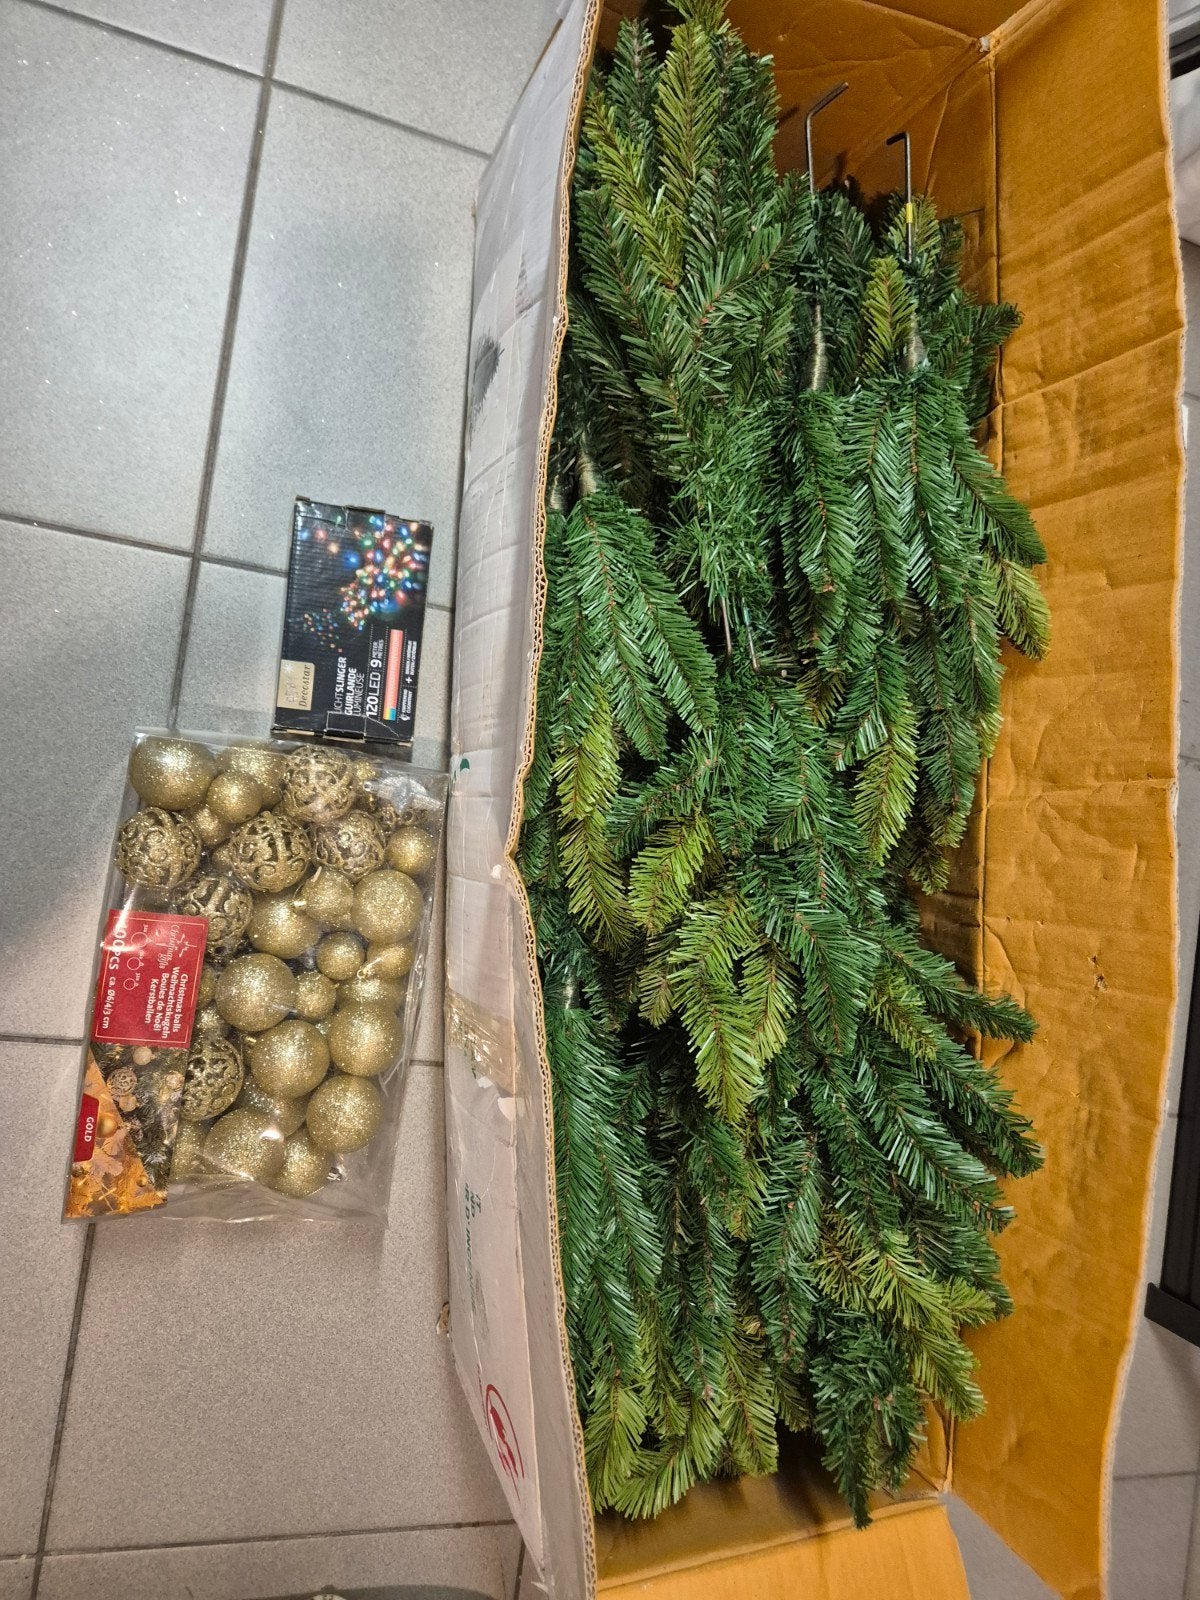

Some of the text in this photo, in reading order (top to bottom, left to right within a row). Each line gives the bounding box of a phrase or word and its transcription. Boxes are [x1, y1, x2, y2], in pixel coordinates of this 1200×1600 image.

[333, 656, 348, 714] LICHTSLINGER
[370, 658, 382, 667] 9
[298, 664, 312, 708] Decostar
[344, 667, 358, 716] GUIRLANDE
[353, 672, 365, 717] LUMINEUSE
[157, 924, 180, 969] Christmas gifts
[104, 989, 116, 1015] Ø6/4/3
[109, 976, 117, 988] ca.
[145, 978, 159, 1024] Kerstballen
[153, 973, 169, 1031] Boules de Noël
[161, 966, 180, 1039] Weihnachtskugeln
[172, 973, 189, 1033] Christmas balls
[102, 1016, 110, 1029] cm
[84, 1116, 94, 1142] GOLD
